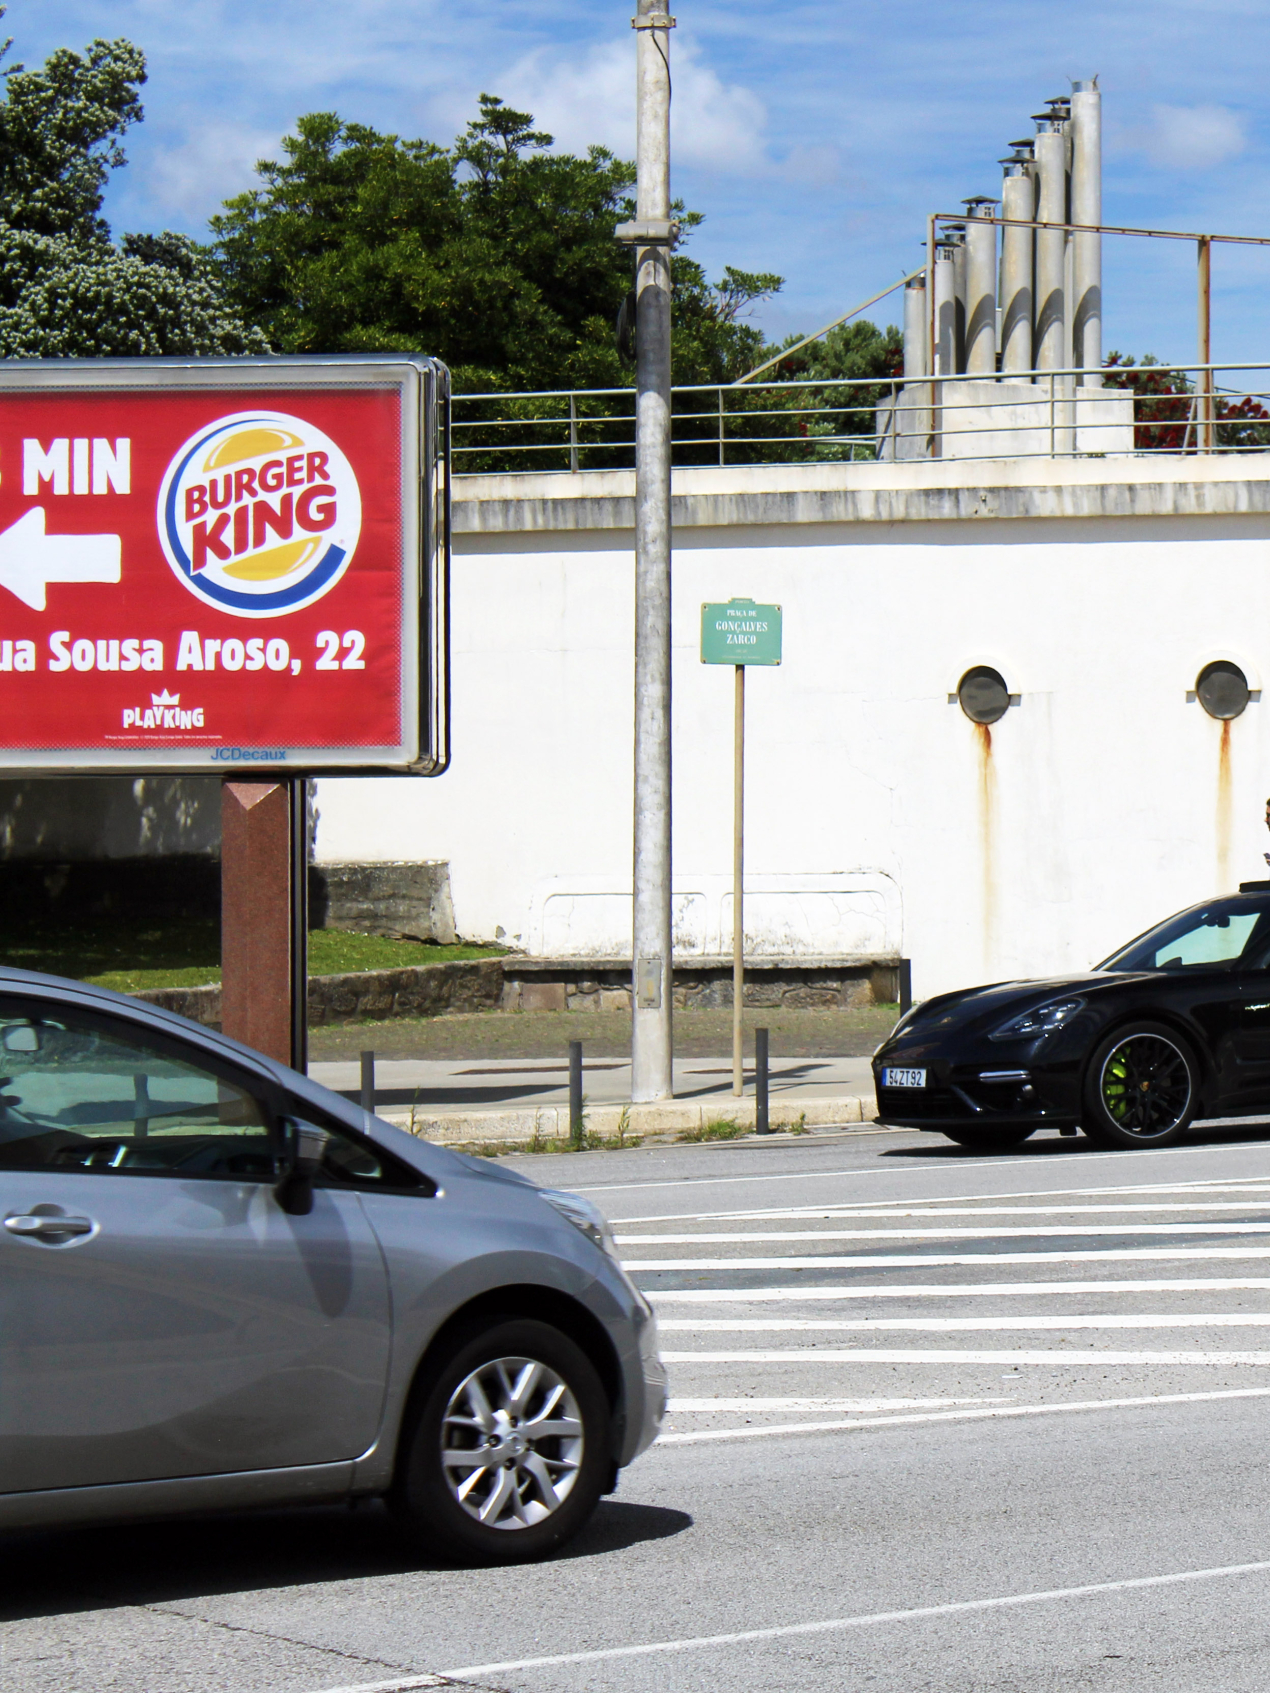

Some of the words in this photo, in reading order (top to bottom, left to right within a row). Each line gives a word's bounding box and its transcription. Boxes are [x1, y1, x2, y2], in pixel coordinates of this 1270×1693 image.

[23, 437, 131, 495] MIN
[185, 450, 331, 523] BURGER
[192, 484, 337, 573] KING
[726, 609, 747, 618] PRAÇA
[715, 620, 768, 633] GONÇALVES
[726, 634, 757, 645] ZARCO
[48, 630, 164, 673] Sousa
[176, 630, 302, 676] Aroso,
[315, 630, 366, 671] 22
[122, 706, 205, 730] PLAYKING
[210, 747, 287, 761] JCDecaux
[889, 1069, 922, 1086] 54ZT92
